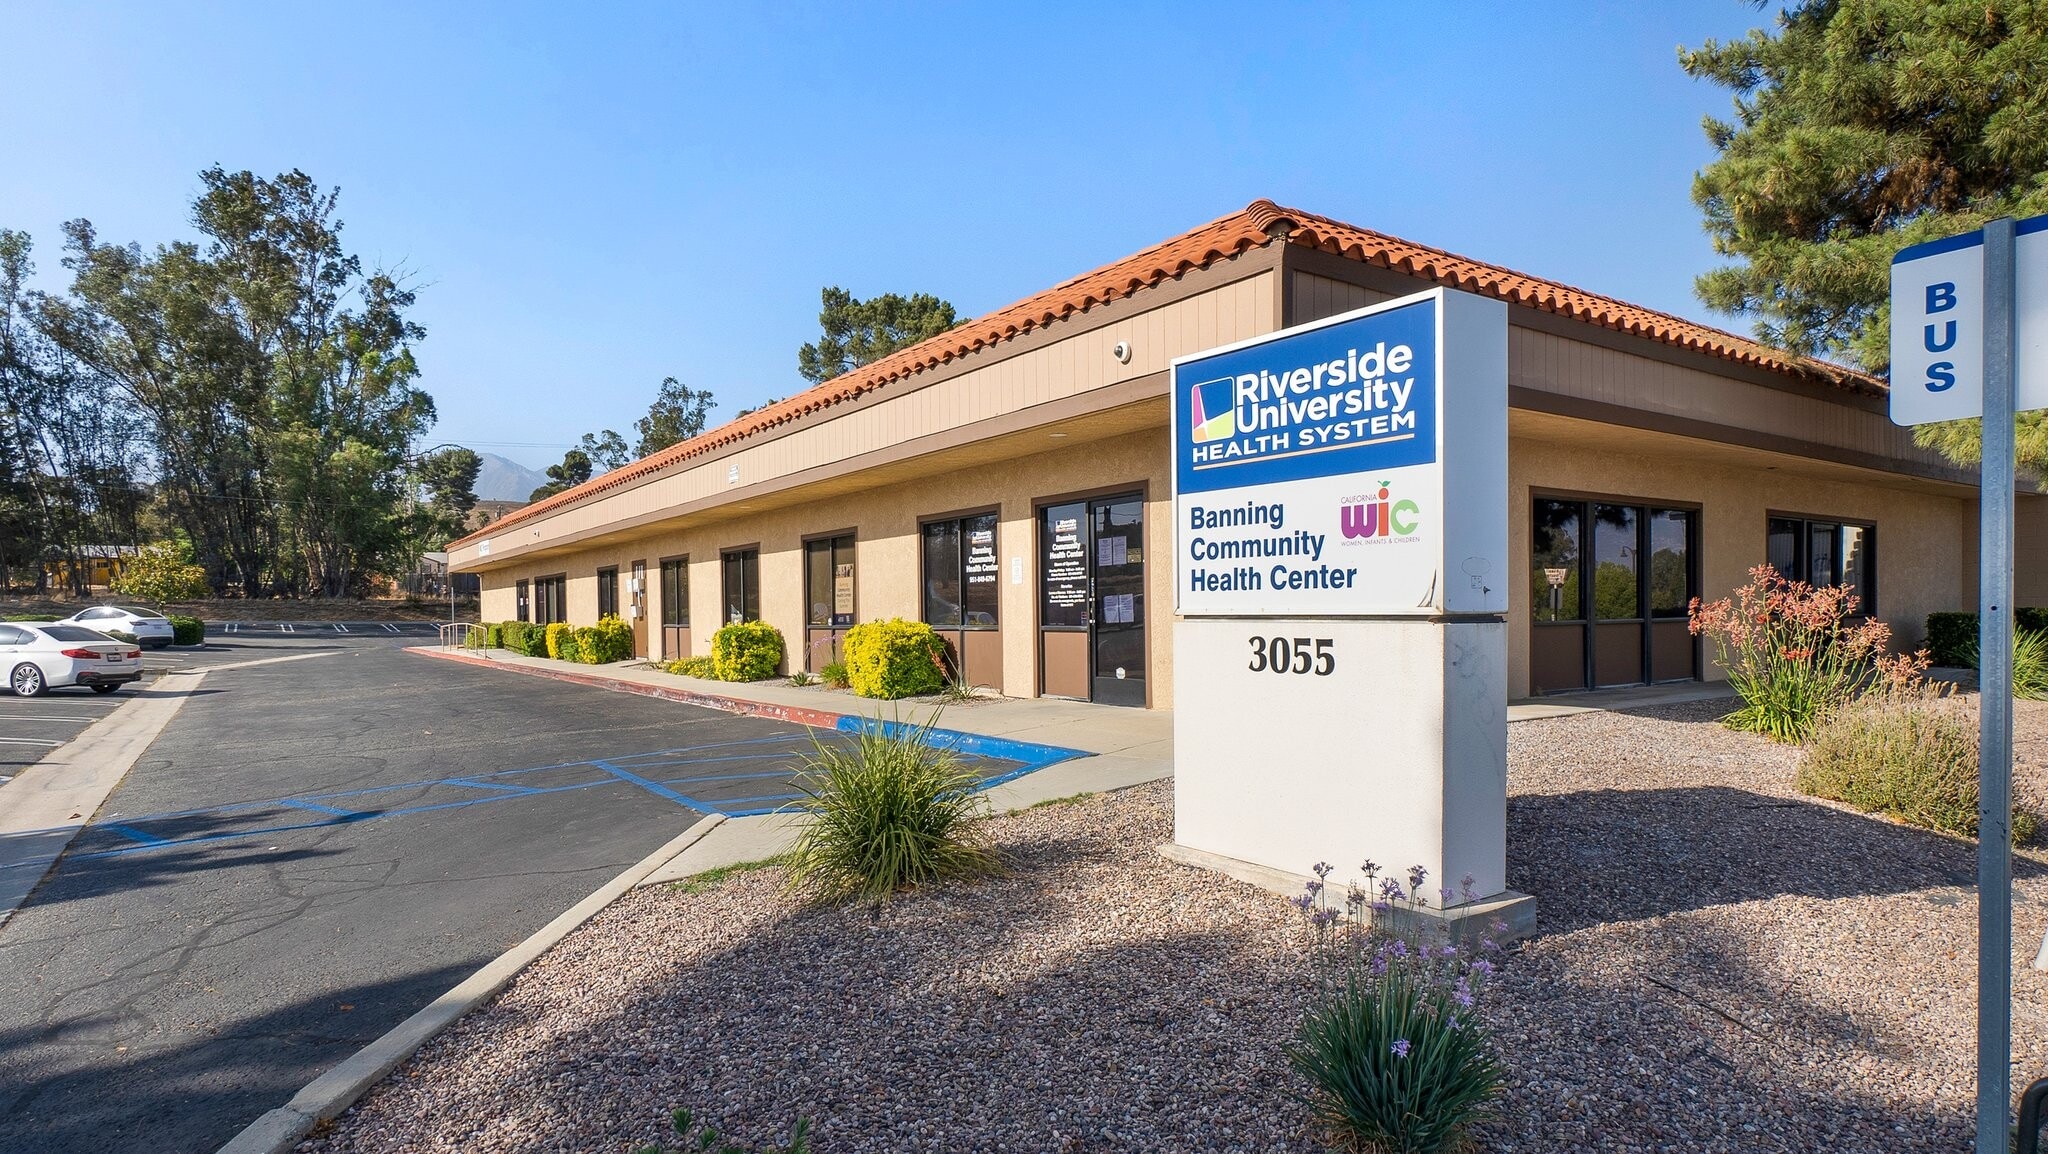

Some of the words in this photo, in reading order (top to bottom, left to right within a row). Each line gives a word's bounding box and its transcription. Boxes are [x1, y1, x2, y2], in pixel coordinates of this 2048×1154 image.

[1924, 281, 1957, 393] BUS
[1236, 342, 1413, 406] Riverside
[1236, 377, 1415, 433] University
[1192, 432, 1289, 463] HEALTH
[1298, 410, 1415, 446] SYSTEM
[1341, 494, 1377, 504] CALIFORNIA
[1191, 501, 1284, 529] Banning
[1049, 551, 1066, 560] Health
[1067, 550, 1083, 558] Center
[1190, 530, 1325, 561] Community
[966, 564, 981, 573] Health
[982, 563, 998, 572] Center
[1191, 566, 1261, 592] Health
[1270, 564, 1357, 590] Center
[1248, 636, 1335, 676] 3055
